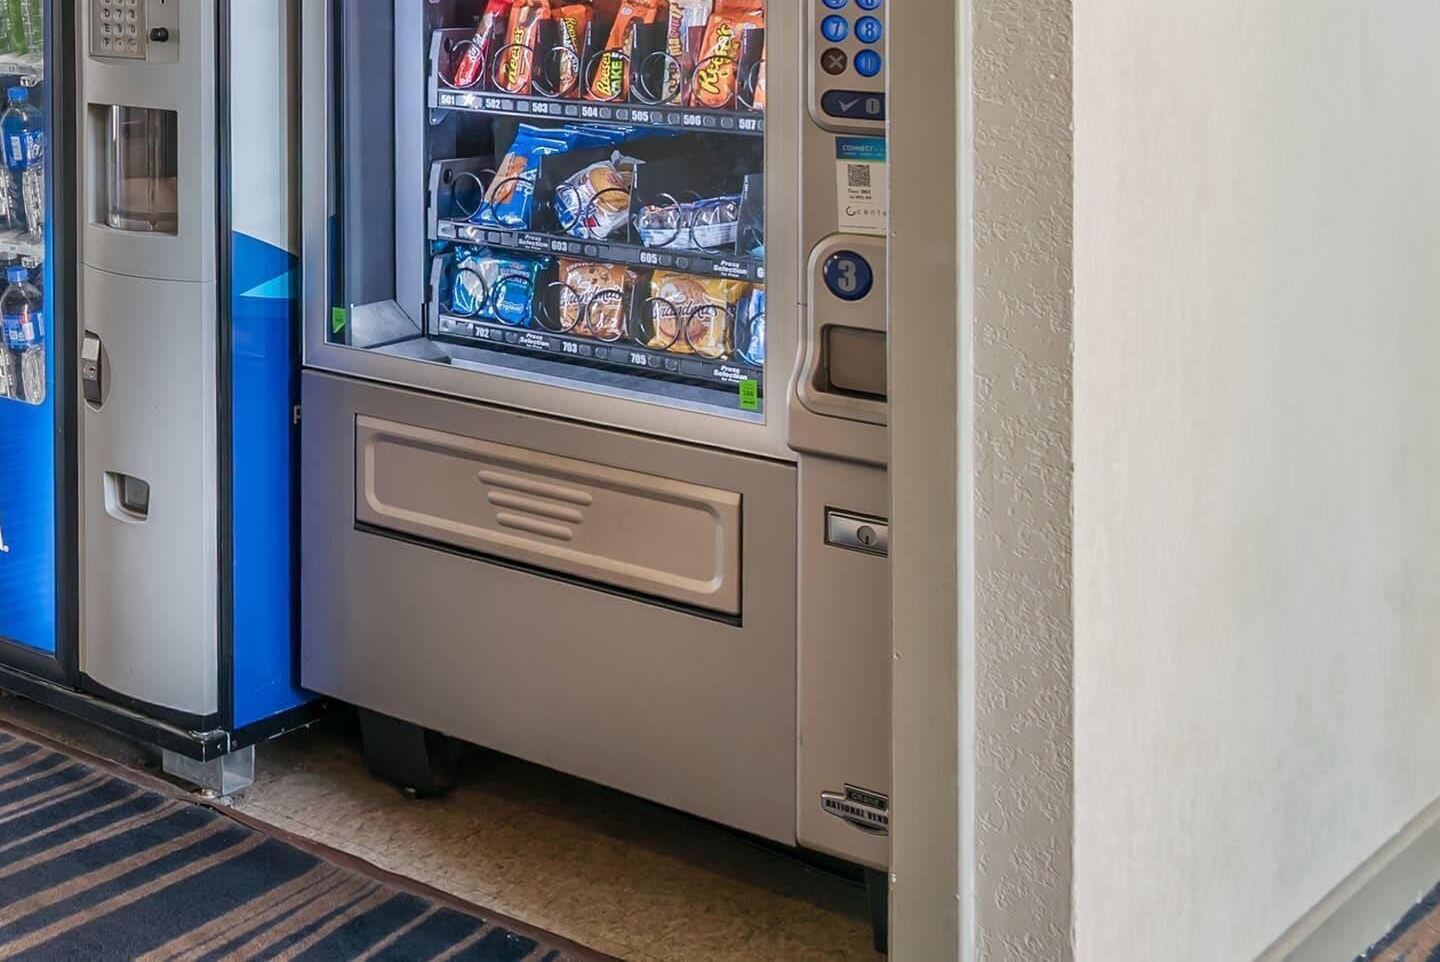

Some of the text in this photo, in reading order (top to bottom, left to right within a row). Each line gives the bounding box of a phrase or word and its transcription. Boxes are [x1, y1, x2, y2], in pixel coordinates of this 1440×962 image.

[832, 21, 874, 37] 7 8
[698, 22, 736, 94] Reese's
[596, 53, 611, 96] Reese's
[441, 96, 455, 104] 501
[486, 100, 500, 109] 502
[532, 104, 548, 113] 503
[582, 107, 598, 117] 504
[632, 110, 648, 121] 505
[684, 115, 701, 125] 506
[739, 120, 756, 130] 507
[519, 239, 548, 248] Selection
[552, 241, 568, 251] 603
[640, 252, 658, 264] 605
[713, 265, 747, 275] Selection
[837, 260, 856, 292] 3
[476, 329, 489, 338] 702
[520, 338, 550, 346] Selection
[563, 343, 577, 353] 703
[631, 353, 646, 365] 705
[713, 370, 747, 380] Selection
[826, 799, 864, 818] NATIONAL
